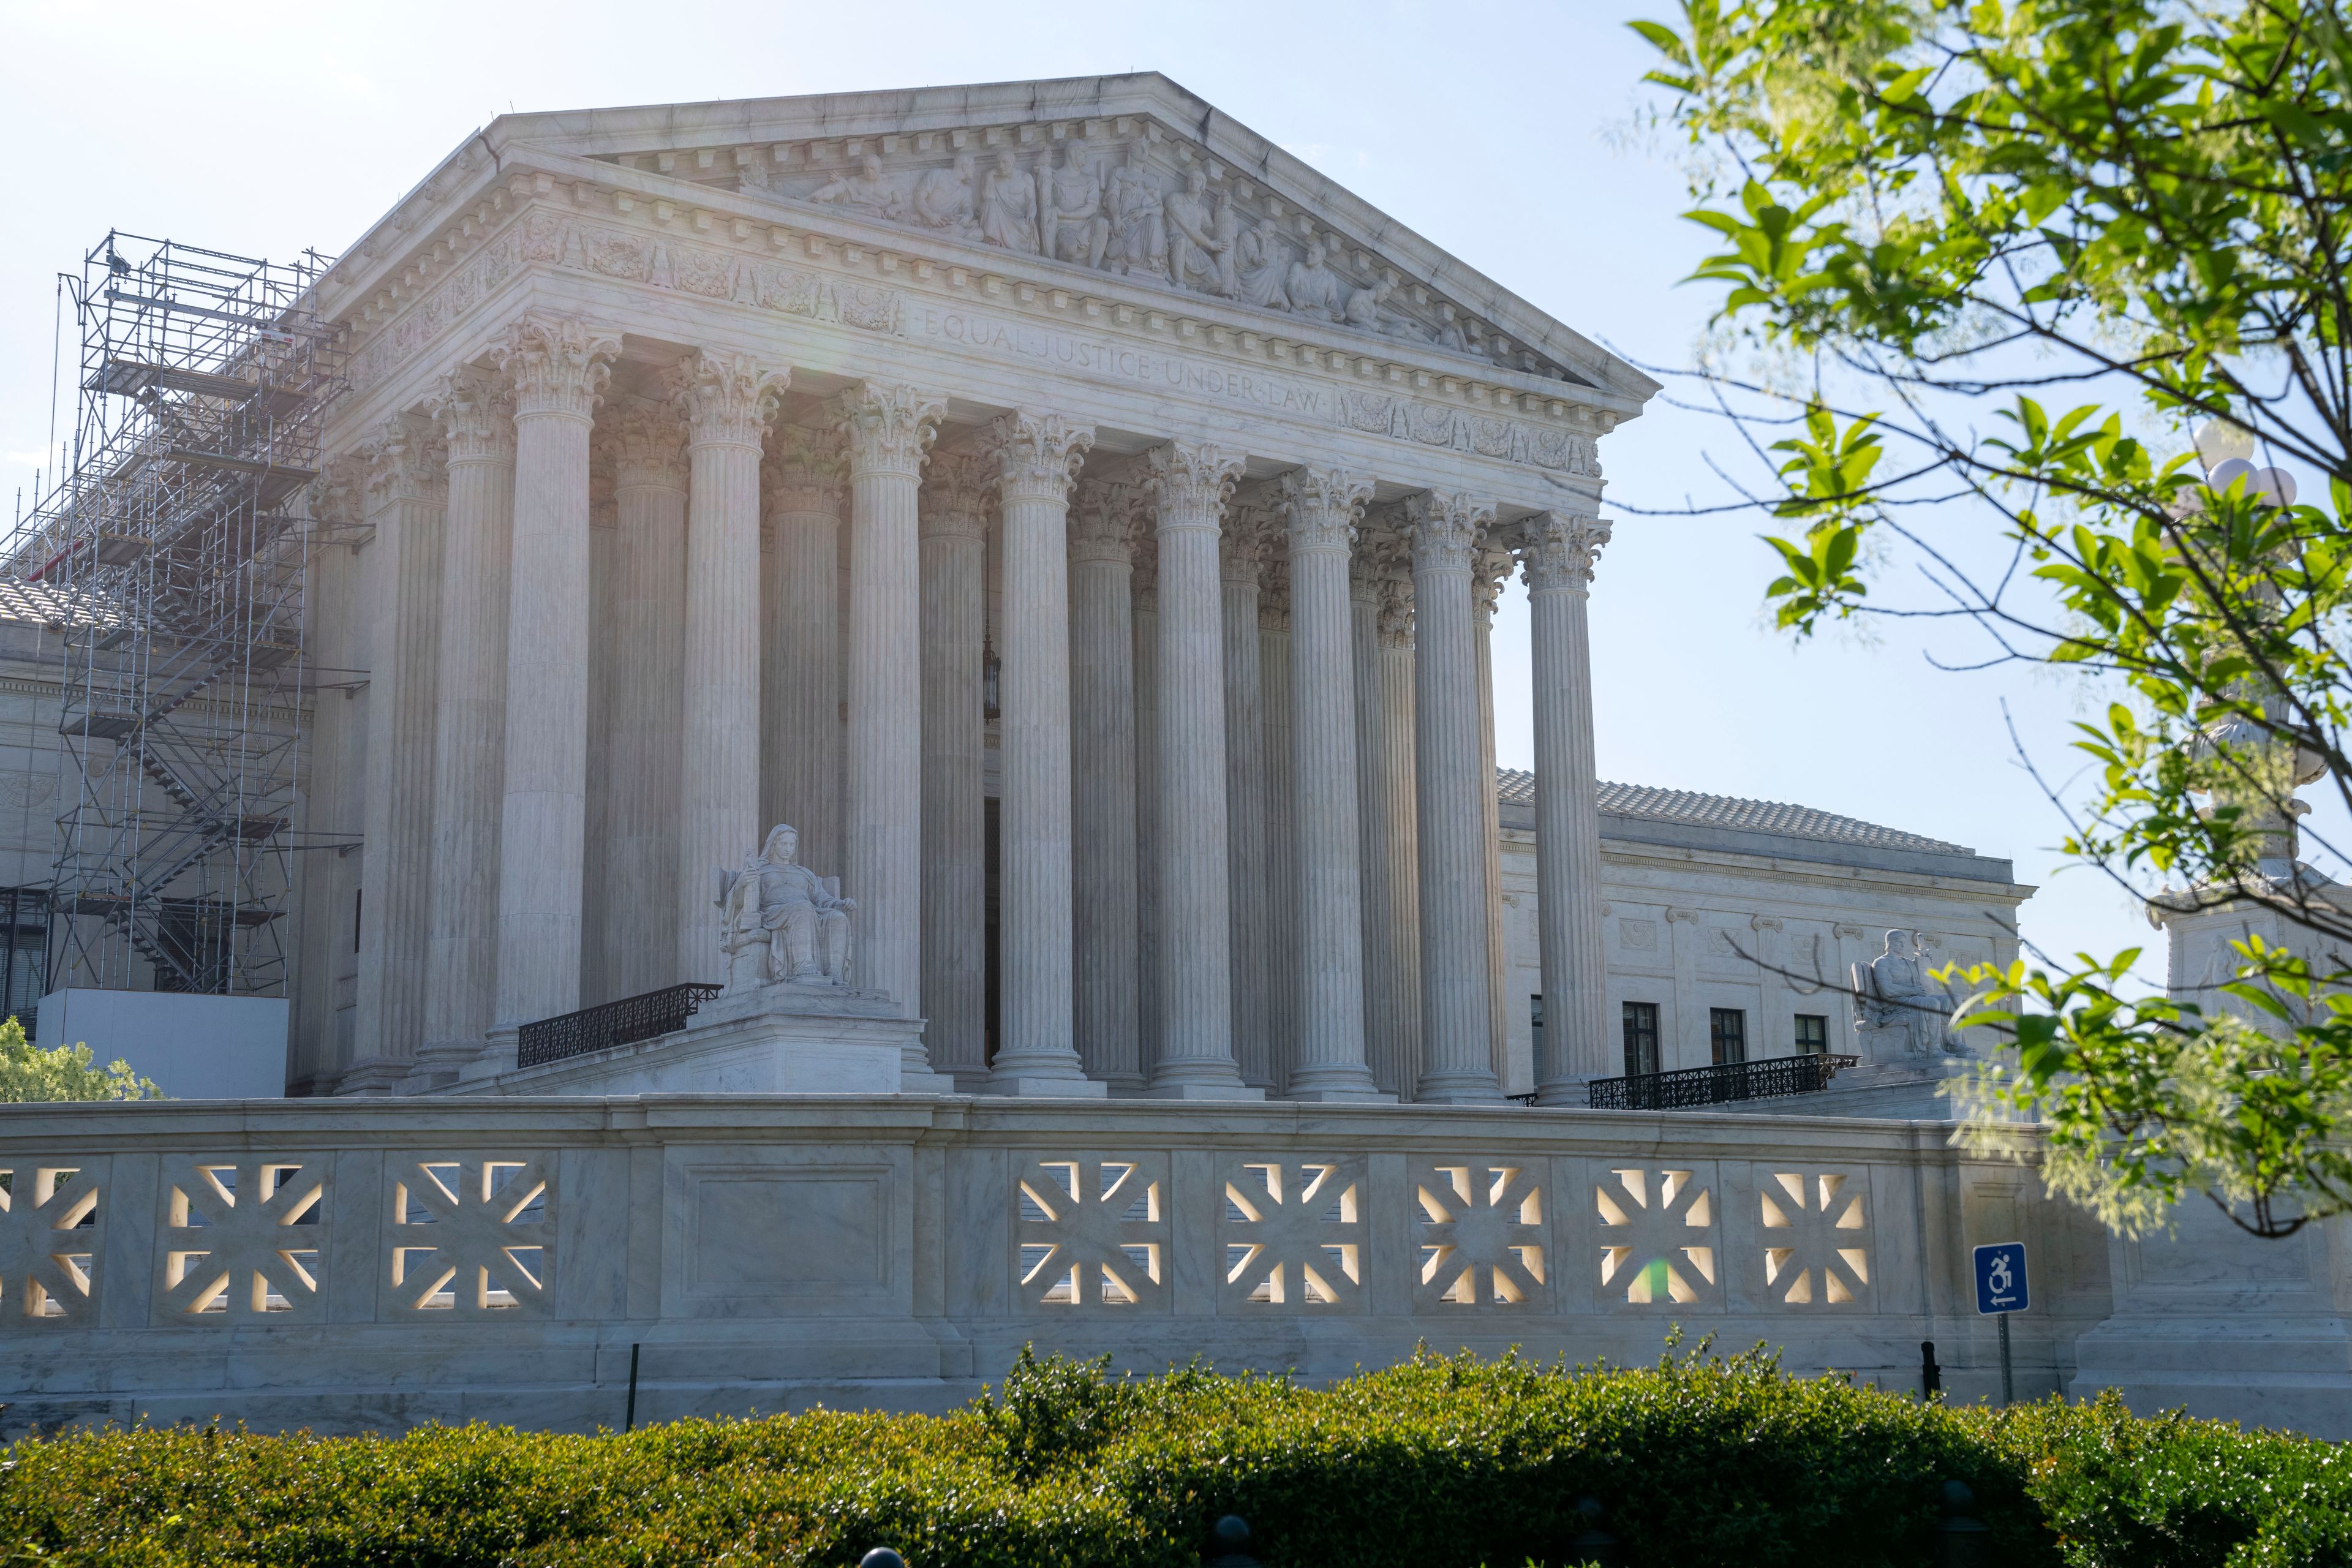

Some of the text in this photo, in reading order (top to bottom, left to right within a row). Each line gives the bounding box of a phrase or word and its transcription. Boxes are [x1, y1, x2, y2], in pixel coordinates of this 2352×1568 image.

[925, 311, 1319, 413] EQUAL JUSTICE UNDER LAW
